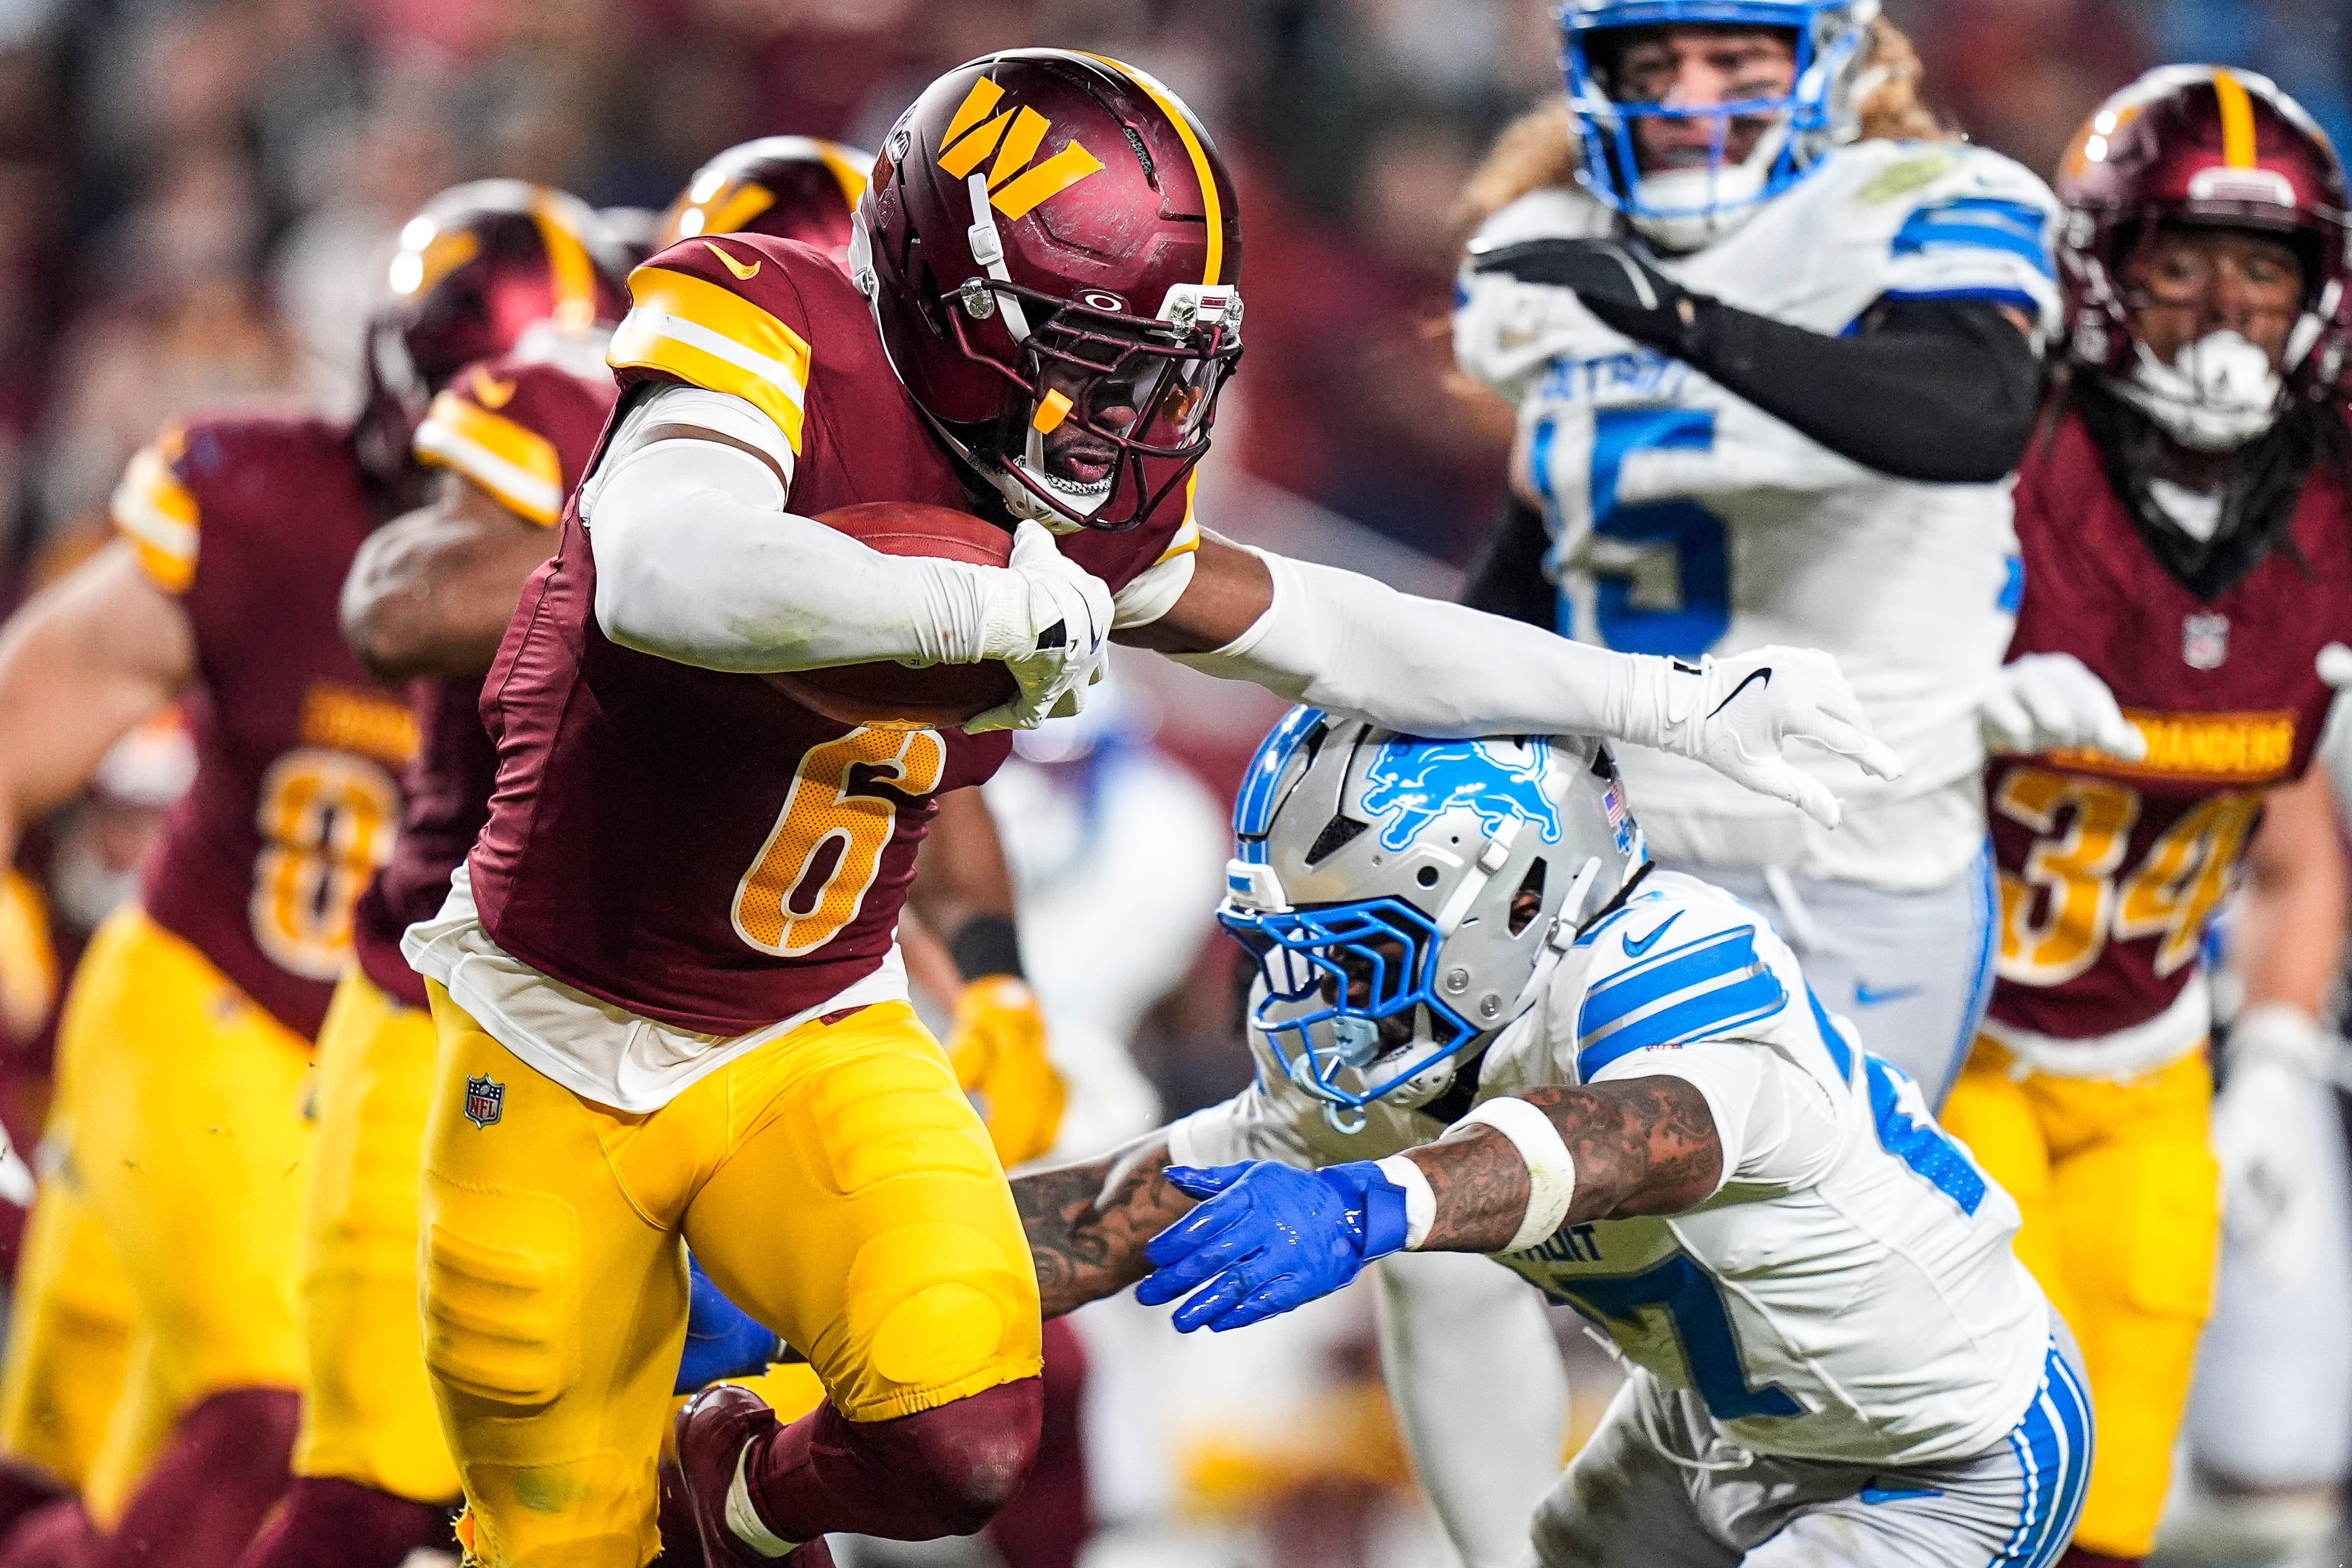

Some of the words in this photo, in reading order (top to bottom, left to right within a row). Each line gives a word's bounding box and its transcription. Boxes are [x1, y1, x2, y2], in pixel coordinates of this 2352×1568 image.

[730, 724, 947, 958] 6
[1992, 768, 2266, 987] 34
[469, 1095, 496, 1119] NFL
